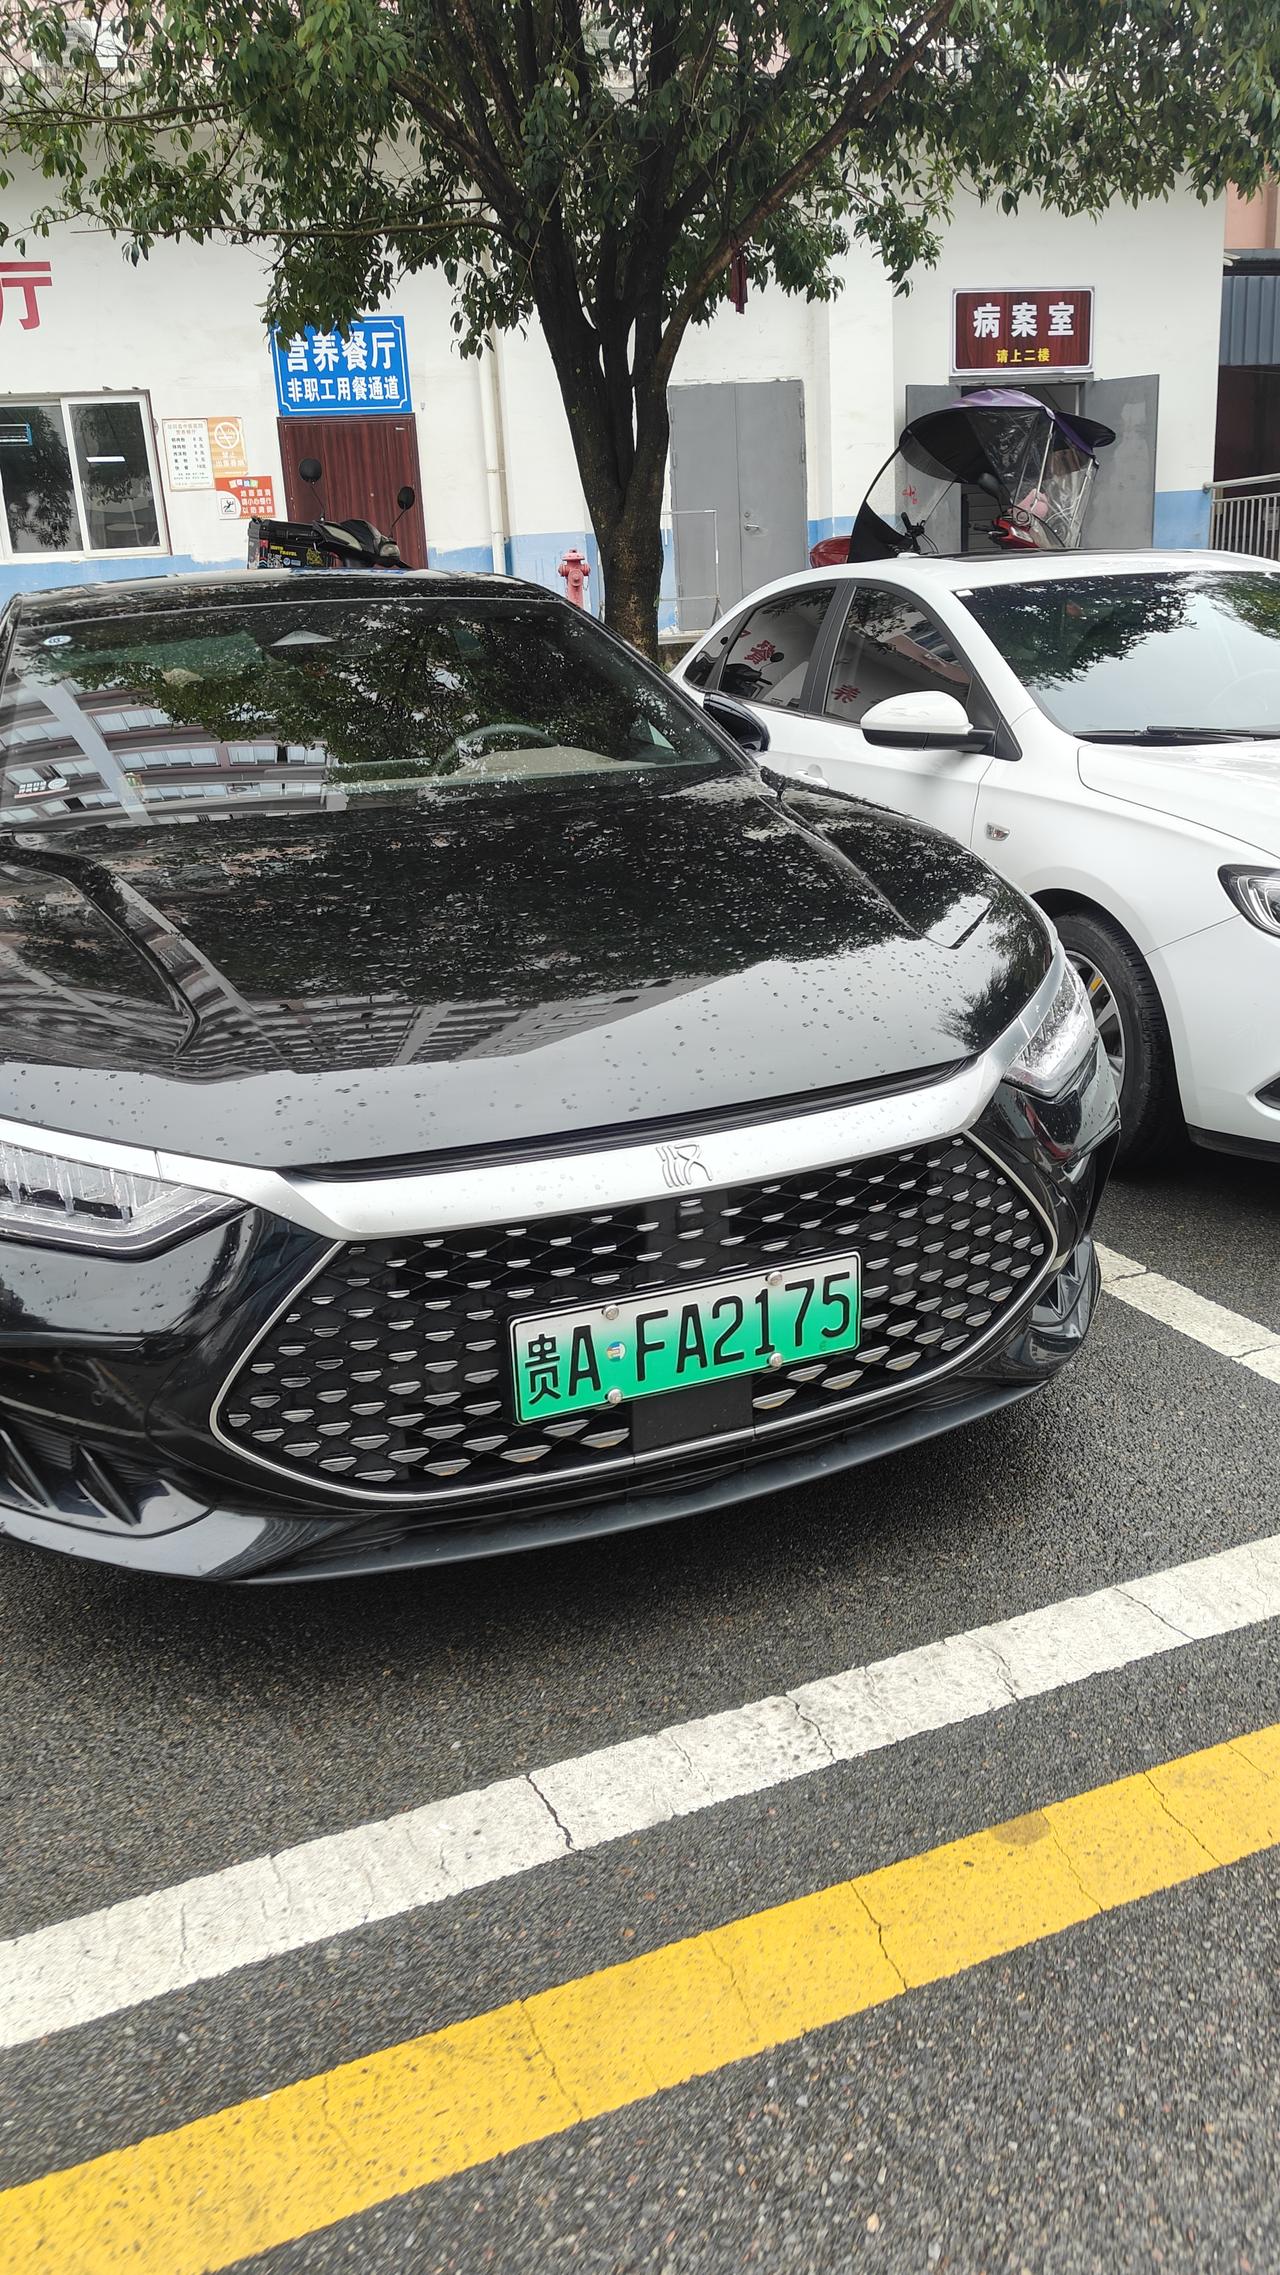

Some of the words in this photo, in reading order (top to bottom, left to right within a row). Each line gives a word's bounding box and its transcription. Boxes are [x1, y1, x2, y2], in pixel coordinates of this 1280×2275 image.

[973, 301, 1074, 338] 病案室
[287, 331, 396, 373] 营养餐厅
[996, 347, 1051, 364] 请上二楼
[287, 375, 400, 402] 非职工用餐通道
